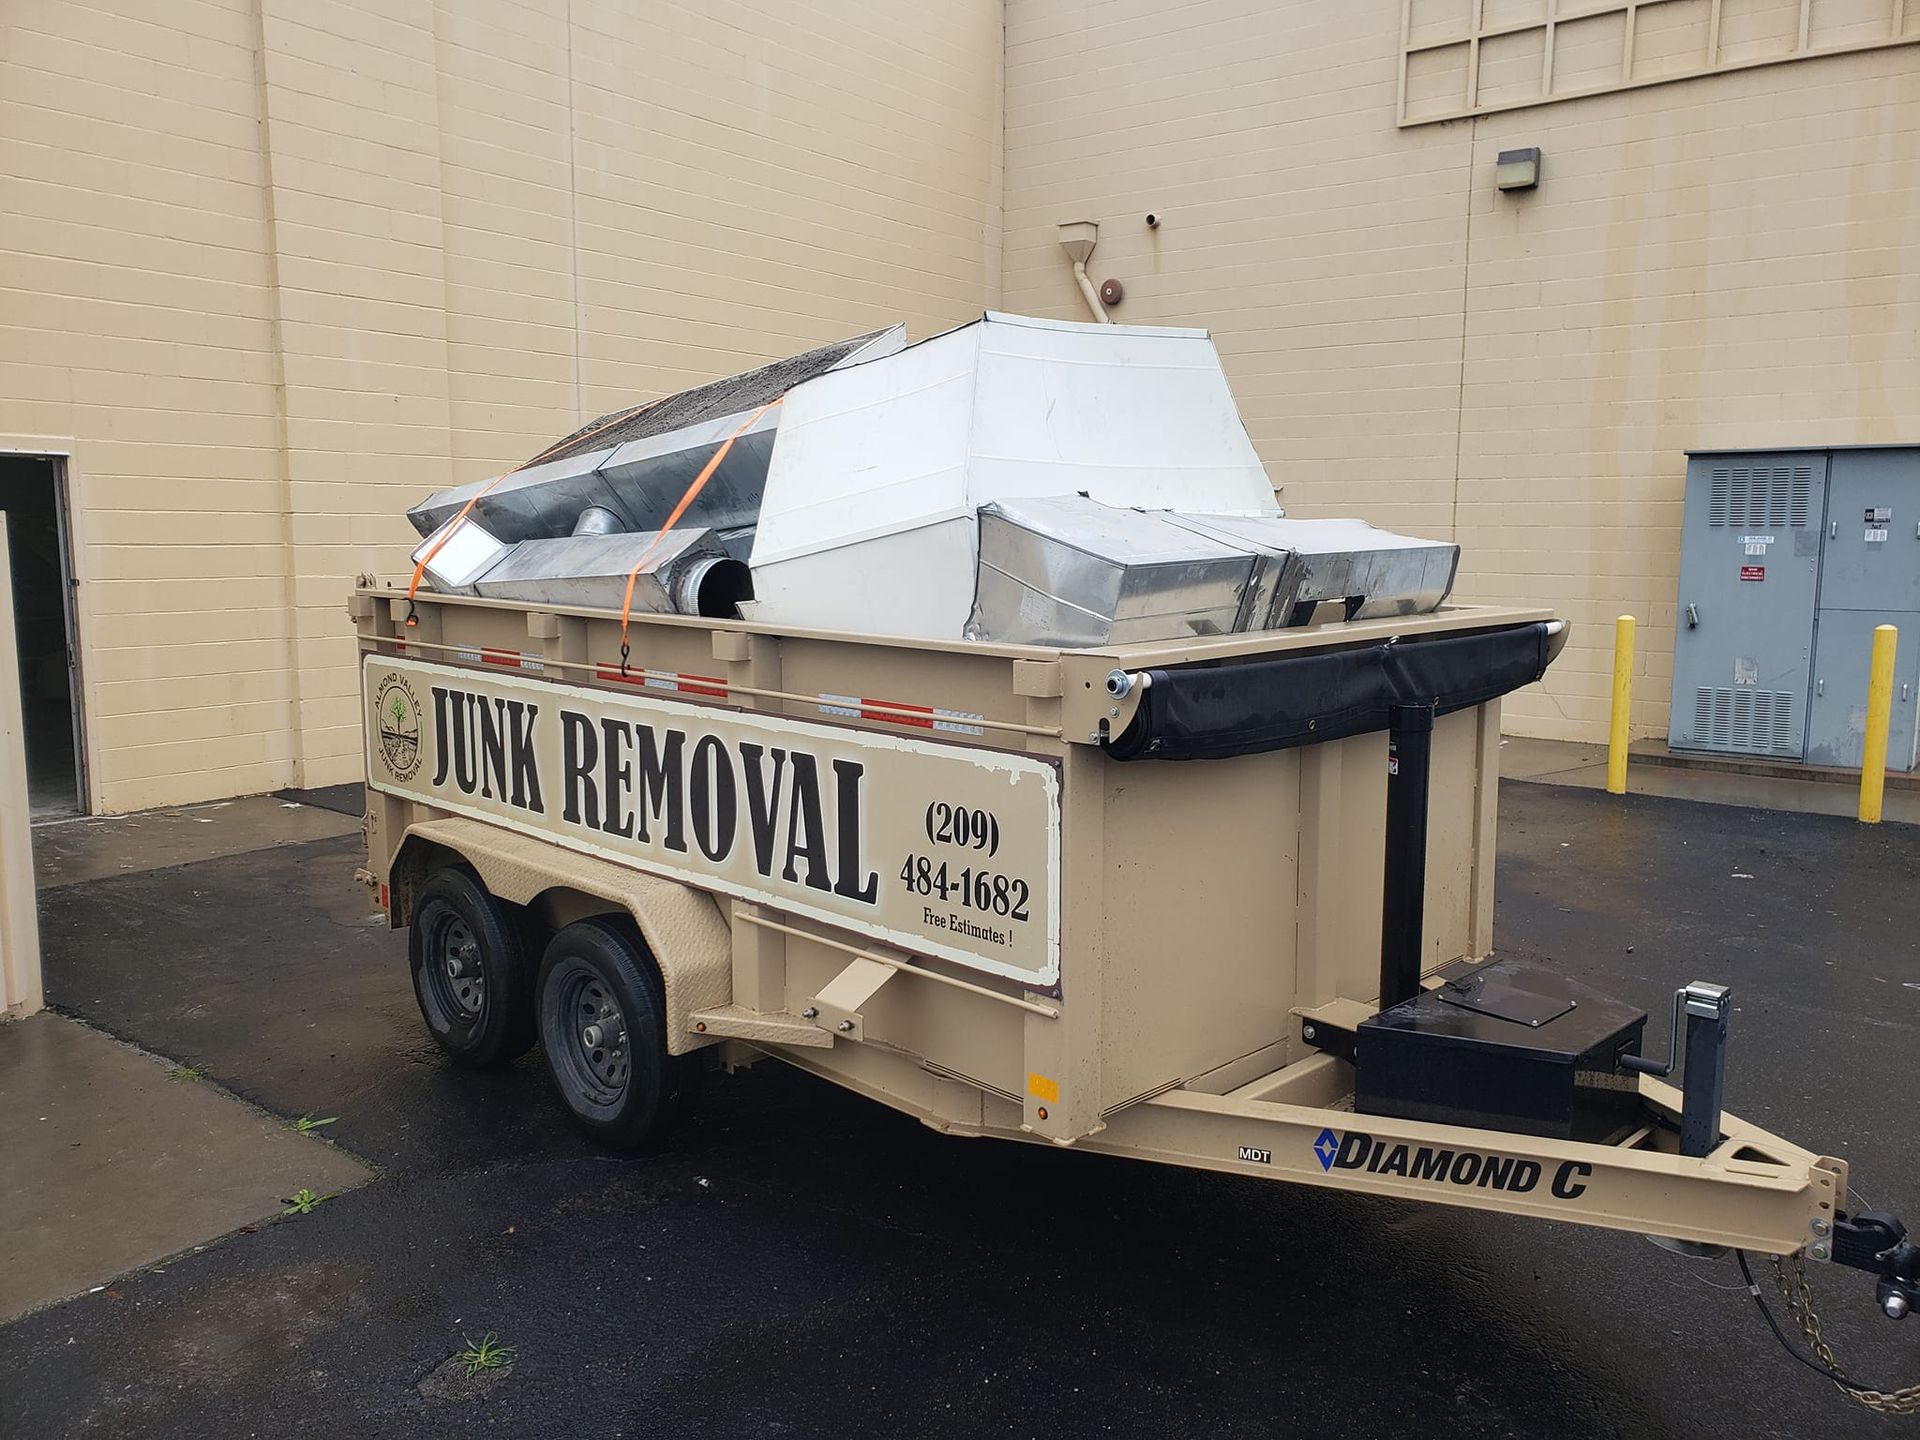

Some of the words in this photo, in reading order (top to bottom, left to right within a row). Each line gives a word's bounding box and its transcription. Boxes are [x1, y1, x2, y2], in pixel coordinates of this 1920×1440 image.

[374, 673, 398, 710] ALMOND
[399, 674, 423, 717] VALLEY
[378, 747, 394, 776] JUNK
[394, 758, 423, 783] REMOVAL
[431, 686, 545, 814] JUNK
[559, 709, 879, 906] REMOVAL
[925, 801, 1000, 858] (209)
[900, 853, 1029, 922] 484-1682
[923, 906, 947, 929] Free
[949, 914, 1005, 946] Estimates
[1239, 1147, 1270, 1163] MDT
[1333, 1130, 1542, 1193] DIAMOND
[1551, 1160, 1593, 1200] C
